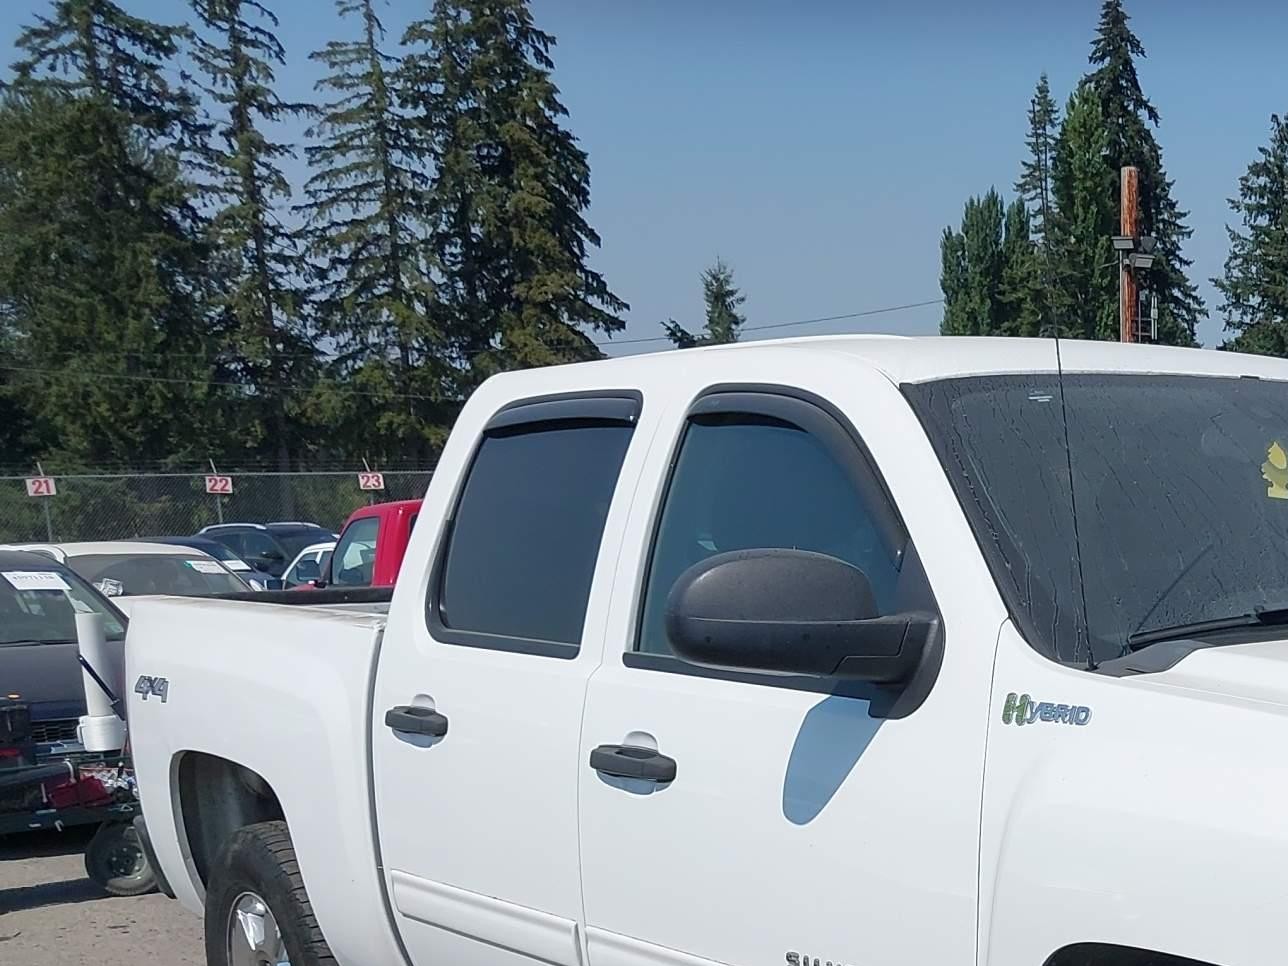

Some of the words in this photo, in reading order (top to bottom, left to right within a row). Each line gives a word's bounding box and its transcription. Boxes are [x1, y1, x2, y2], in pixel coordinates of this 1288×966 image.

[31, 479, 51, 495] 21
[208, 477, 230, 492] 22
[361, 475, 382, 488] 23
